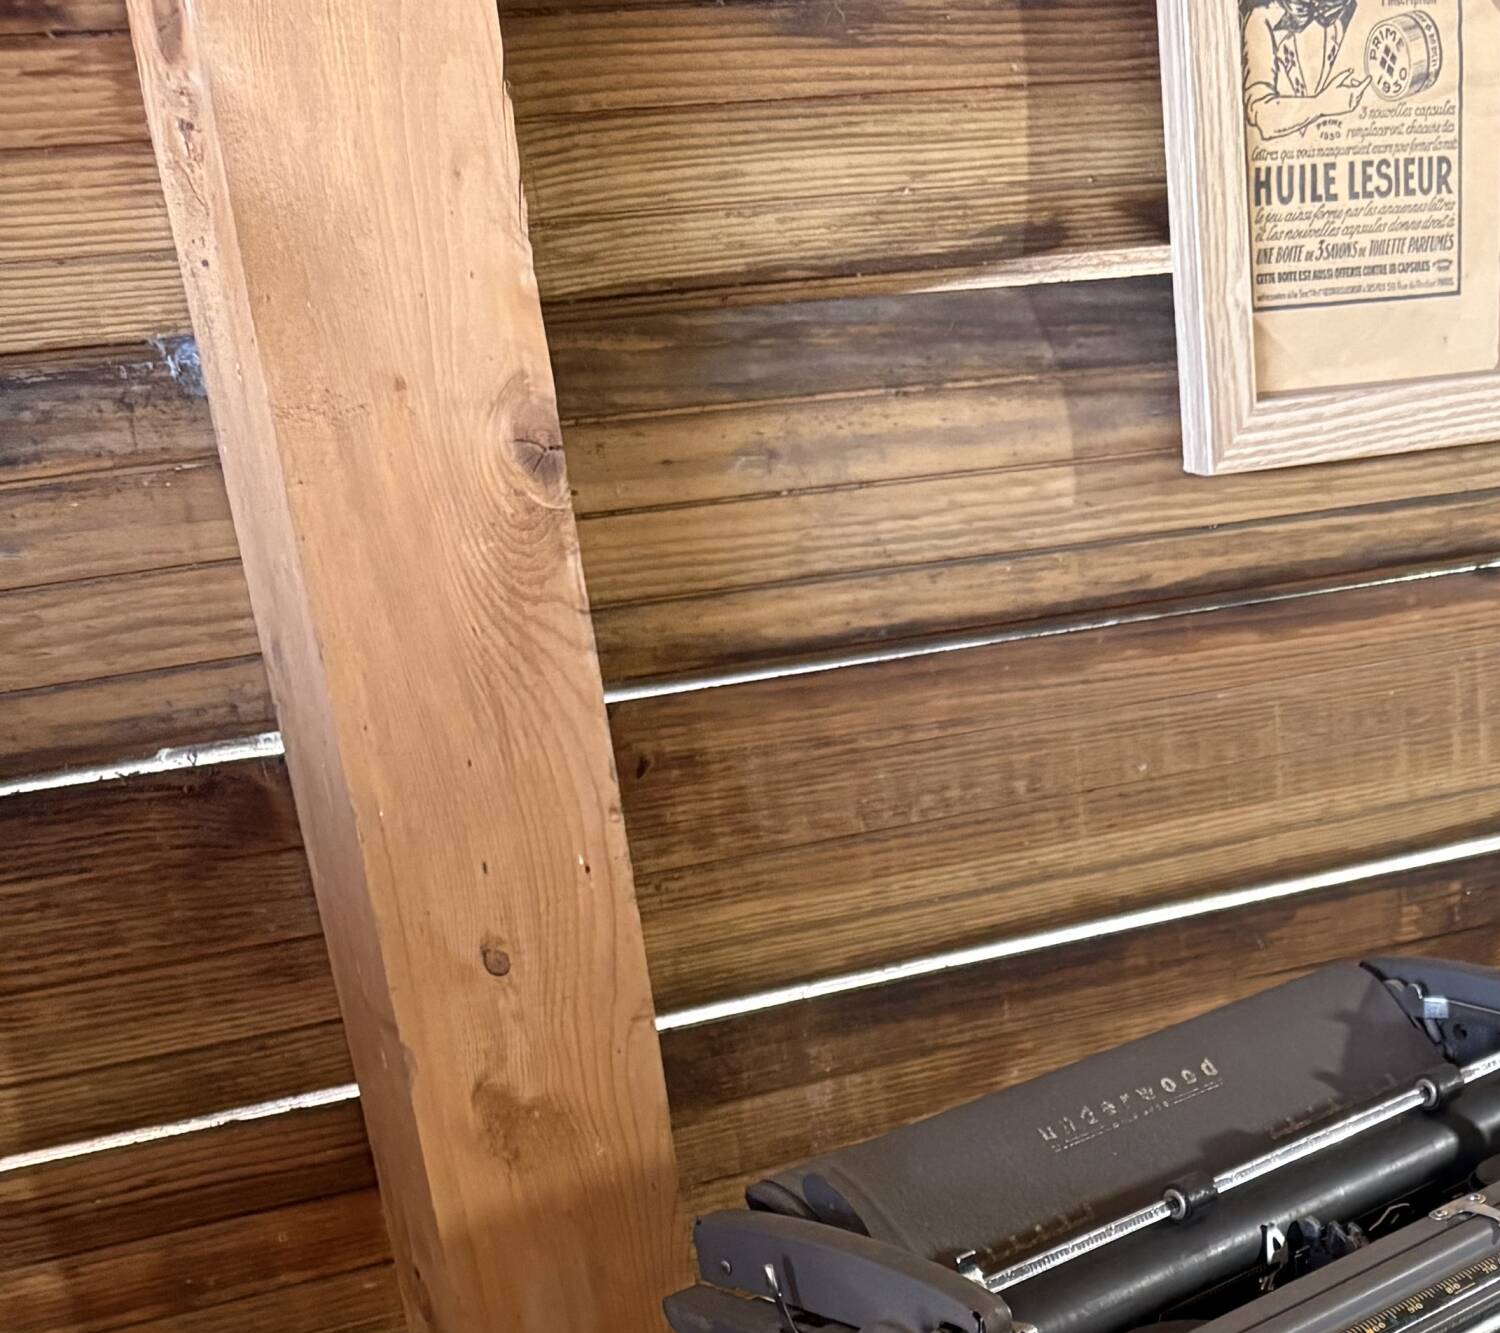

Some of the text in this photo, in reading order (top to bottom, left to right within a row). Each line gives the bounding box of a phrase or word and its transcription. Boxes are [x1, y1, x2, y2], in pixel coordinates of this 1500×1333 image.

[1369, 27, 1405, 61] PRIME
[1377, 67, 1408, 94] 1930
[1368, 102, 1413, 119] nouvelles
[1414, 100, 1456, 120] capsules
[1316, 119, 1342, 130] PRIME
[1254, 155, 1453, 207] HUILE LESIEUR
[1284, 220, 1340, 241] nouvelles
[1257, 247, 1275, 265] UNE
[1324, 241, 1358, 260] SAVONS
[1369, 237, 1408, 257] TOILETTE
[1257, 272, 1276, 285] CETTE
[1299, 269, 1311, 281] EST
[1397, 261, 1430, 273] CAPSULES
